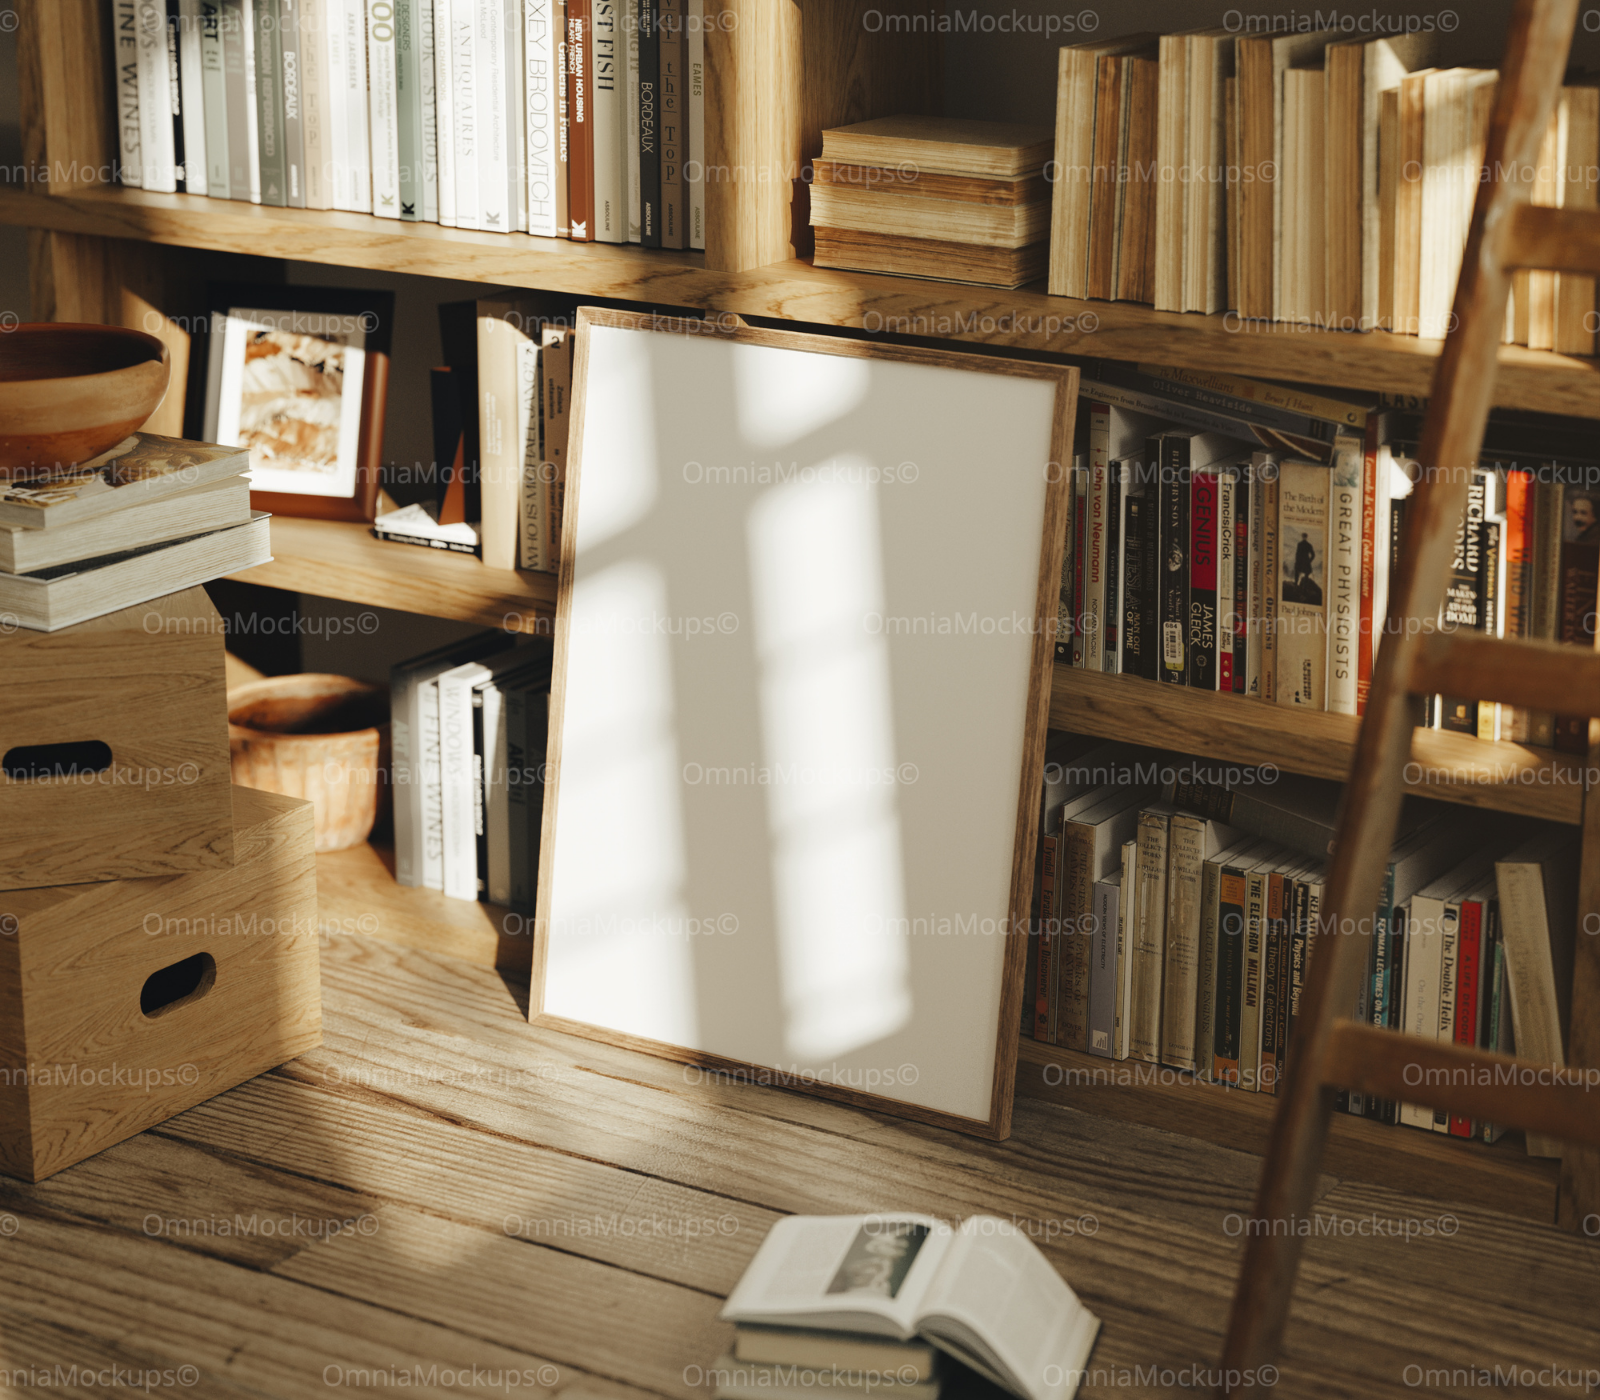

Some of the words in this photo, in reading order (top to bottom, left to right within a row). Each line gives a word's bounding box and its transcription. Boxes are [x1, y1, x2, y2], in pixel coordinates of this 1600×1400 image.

[202, 2, 219, 42] ART
[401, 4, 410, 50] DESIGNERS
[421, 8, 434, 62] BOOK
[489, 9, 498, 65] Contemporary
[348, 41, 357, 89] JACOBSEN
[438, 49, 446, 101] CHAMPIONS
[558, 42, 569, 97] Gardens
[575, 43, 583, 77] URBAN
[597, 39, 615, 92] FISH
[692, 63, 701, 96] EAMES
[283, 51, 297, 119] BORDEAUX
[459, 20, 474, 157] ANTIQUAIRES
[491, 68, 500, 112] Residential
[576, 79, 584, 123] HOUSING
[122, 63, 140, 154] WINES
[559, 100, 569, 113] in
[641, 82, 653, 153] BORDEAUX
[422, 85, 438, 183] SYMBOLS
[492, 114, 500, 161] Architecture
[529, 60, 549, 216] BRODOVITCH
[559, 116, 570, 162] France
[1153, 382, 1190, 396] Oliver
[1195, 390, 1252, 414] Heaviside
[1171, 369, 1235, 394] Maxwellians
[1092, 461, 1105, 491] John
[1284, 491, 1297, 501] The
[527, 503, 538, 520] IS
[1092, 496, 1101, 518] von
[1171, 481, 1179, 528] BRYSON
[1283, 504, 1295, 513] the
[1296, 504, 1324, 516] Modern
[1338, 493, 1352, 555] GREAT
[1195, 487, 1211, 565] GENIUS
[1252, 517, 1260, 552] Language
[1466, 485, 1483, 572] RICHARD
[527, 530, 539, 570] WHO
[1091, 522, 1102, 583] Neumann
[1266, 531, 1275, 575] FEELING
[1126, 611, 1133, 623] OF
[1190, 602, 1201, 647] GLEICK
[1202, 603, 1213, 649] JAMES
[1265, 597, 1275, 650] ORGANISM
[1281, 606, 1295, 614] Paul
[1335, 565, 1351, 680] PHYSICISTS
[445, 686, 463, 778] WINDOWS
[426, 782, 442, 860] WINES
[1043, 846, 1055, 877] Tyndall
[1041, 889, 1052, 925] Faraday
[1207, 871, 1216, 905] Babbage
[1250, 880, 1261, 899] THE
[1271, 886, 1280, 914] Lorentz
[1042, 927, 1051, 938] as
[1101, 930, 1106, 938] OF
[1248, 903, 1260, 953] ELECTRON
[1270, 925, 1278, 943] the
[1376, 918, 1387, 957] FEYNMAN
[1444, 934, 1455, 953] The
[1203, 917, 1214, 987] CALCULATING
[1266, 947, 1278, 980] theory
[1280, 940, 1288, 975] Chemical
[1292, 939, 1303, 969] Physics
[1464, 955, 1472, 963] A
[1040, 949, 1051, 997] Discoverer
[1246, 958, 1258, 1007] MILLIKAN
[1267, 984, 1276, 996] of
[1292, 970, 1301, 985] and
[1375, 959, 1386, 998] LECTURES
[1417, 980, 1426, 993] On
[1442, 957, 1454, 997] Double
[1462, 965, 1471, 989] LIFE
[1202, 991, 1211, 1033] ENGINES
[1290, 987, 1301, 1016] Beyond
[1374, 1000, 1385, 1012] ON
[1417, 996, 1426, 1011] the
[1440, 1001, 1452, 1032] Helix
[1460, 993, 1470, 1045] DECODED
[1264, 999, 1276, 1047] electrons
